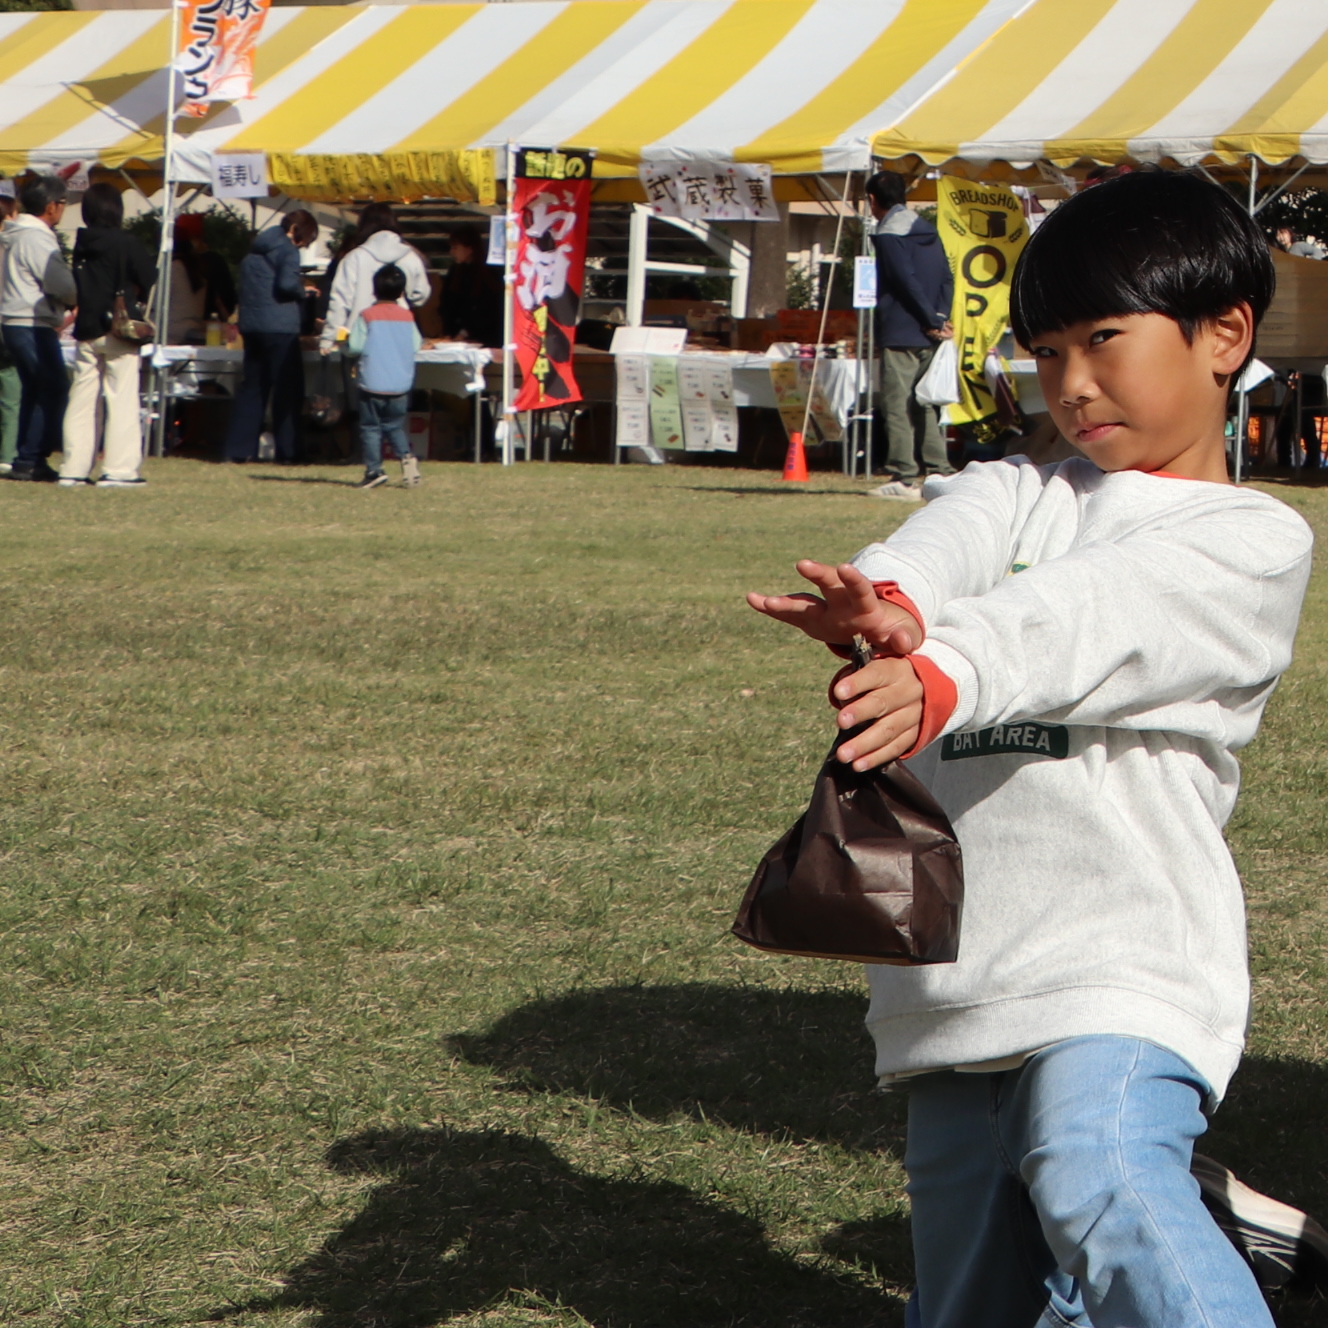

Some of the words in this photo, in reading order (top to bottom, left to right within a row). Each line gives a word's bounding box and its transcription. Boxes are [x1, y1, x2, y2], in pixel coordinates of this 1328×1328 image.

[647, 174, 770, 209] 武蔵製菓
[515, 190, 577, 311] お酒
[962, 245, 1006, 410] OPEN
[989, 725, 1051, 751] AREA
